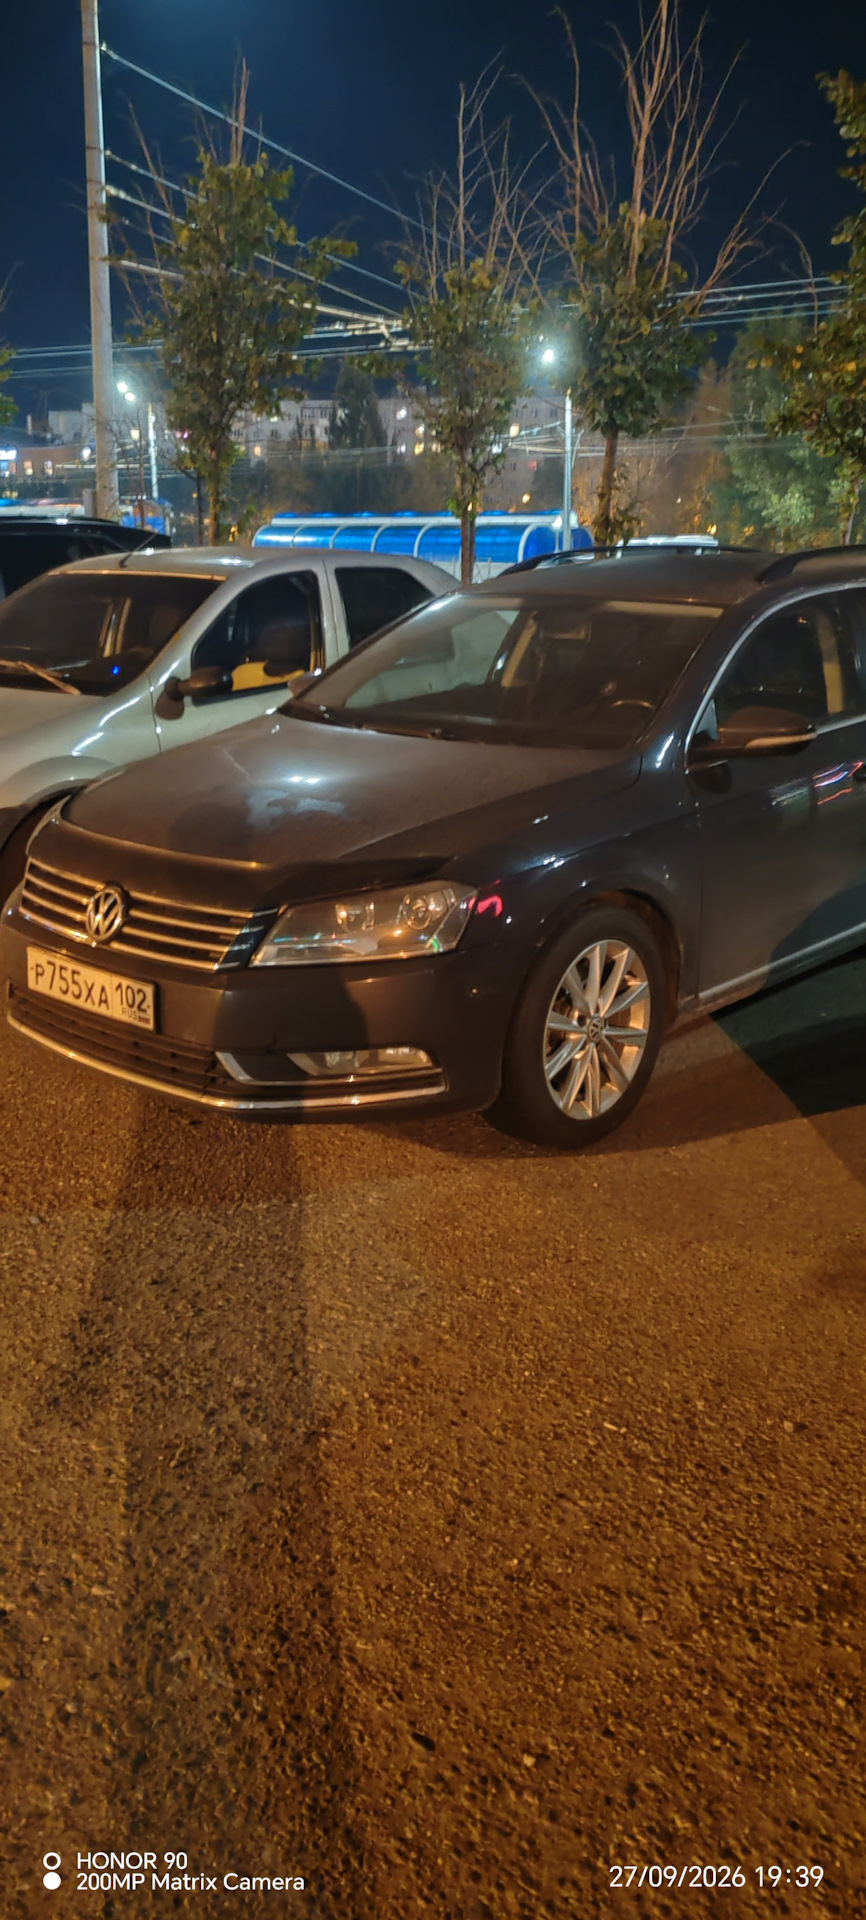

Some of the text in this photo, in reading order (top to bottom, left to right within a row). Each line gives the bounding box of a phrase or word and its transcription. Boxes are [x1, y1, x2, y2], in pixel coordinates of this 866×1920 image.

[35, 960, 147, 1013] Р755ХА 102
[122, 1007, 138, 1020] RUS
